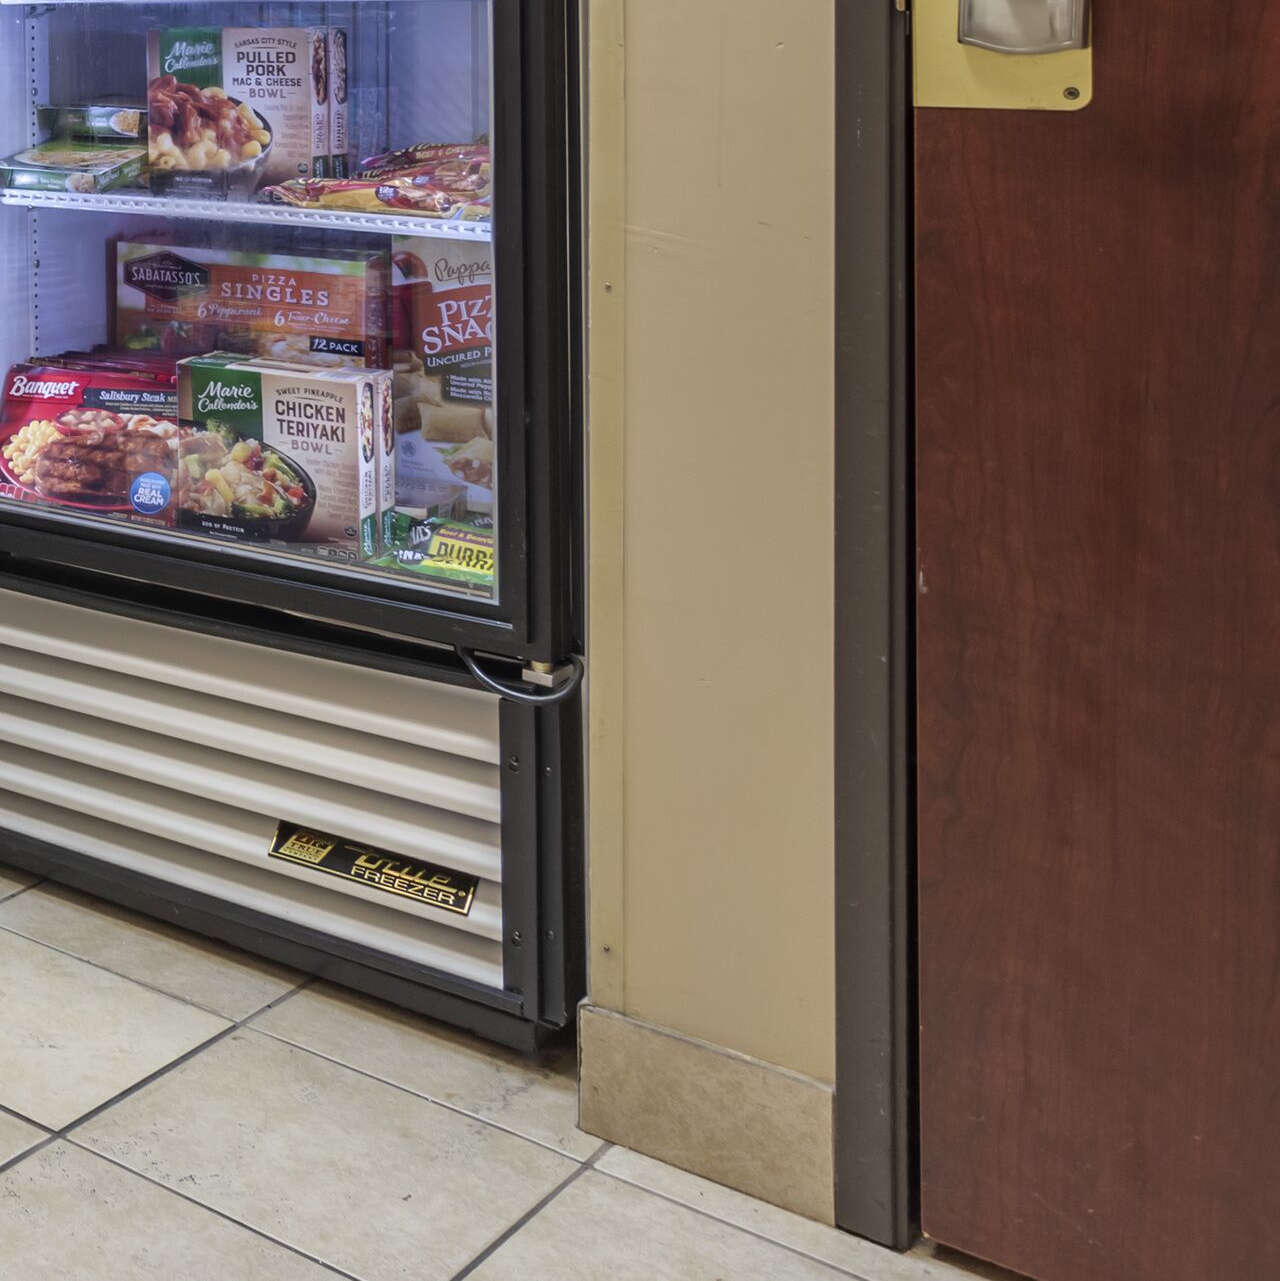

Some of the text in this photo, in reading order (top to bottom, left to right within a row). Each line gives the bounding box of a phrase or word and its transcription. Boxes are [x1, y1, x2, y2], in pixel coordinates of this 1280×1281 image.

[167, 41, 214, 58] Marie
[277, 38, 297, 49] STYLE
[165, 56, 218, 73] Callender's
[237, 52, 296, 64] PULLED
[246, 65, 286, 76] PORK
[232, 78, 302, 87] MAC & CHEESE
[249, 88, 286, 99] BOWL
[131, 267, 204, 287] SABATASSO'S
[252, 274, 296, 286] PIZZA
[221, 283, 329, 306] SINGLES
[197, 301, 263, 319] 6 Pepperoni
[312, 338, 358, 353] 12 PACK
[427, 351, 481, 367] UNCURED
[10, 376, 79, 398] Banquet
[198, 381, 254, 398] Marie
[99, 391, 165, 403] Salisbury Steak
[276, 387, 344, 404] SWEET PINEAPPLE
[198, 398, 259, 412] Callender's
[275, 400, 345, 424] CHICKEN
[276, 418, 345, 443] TERIYAKI
[292, 440, 332, 455] BOWL
[134, 494, 164, 506] CREAM
[137, 488, 162, 497] REAL
[289, 841, 324, 856] TRUE
[351, 865, 457, 906] FREEZER
